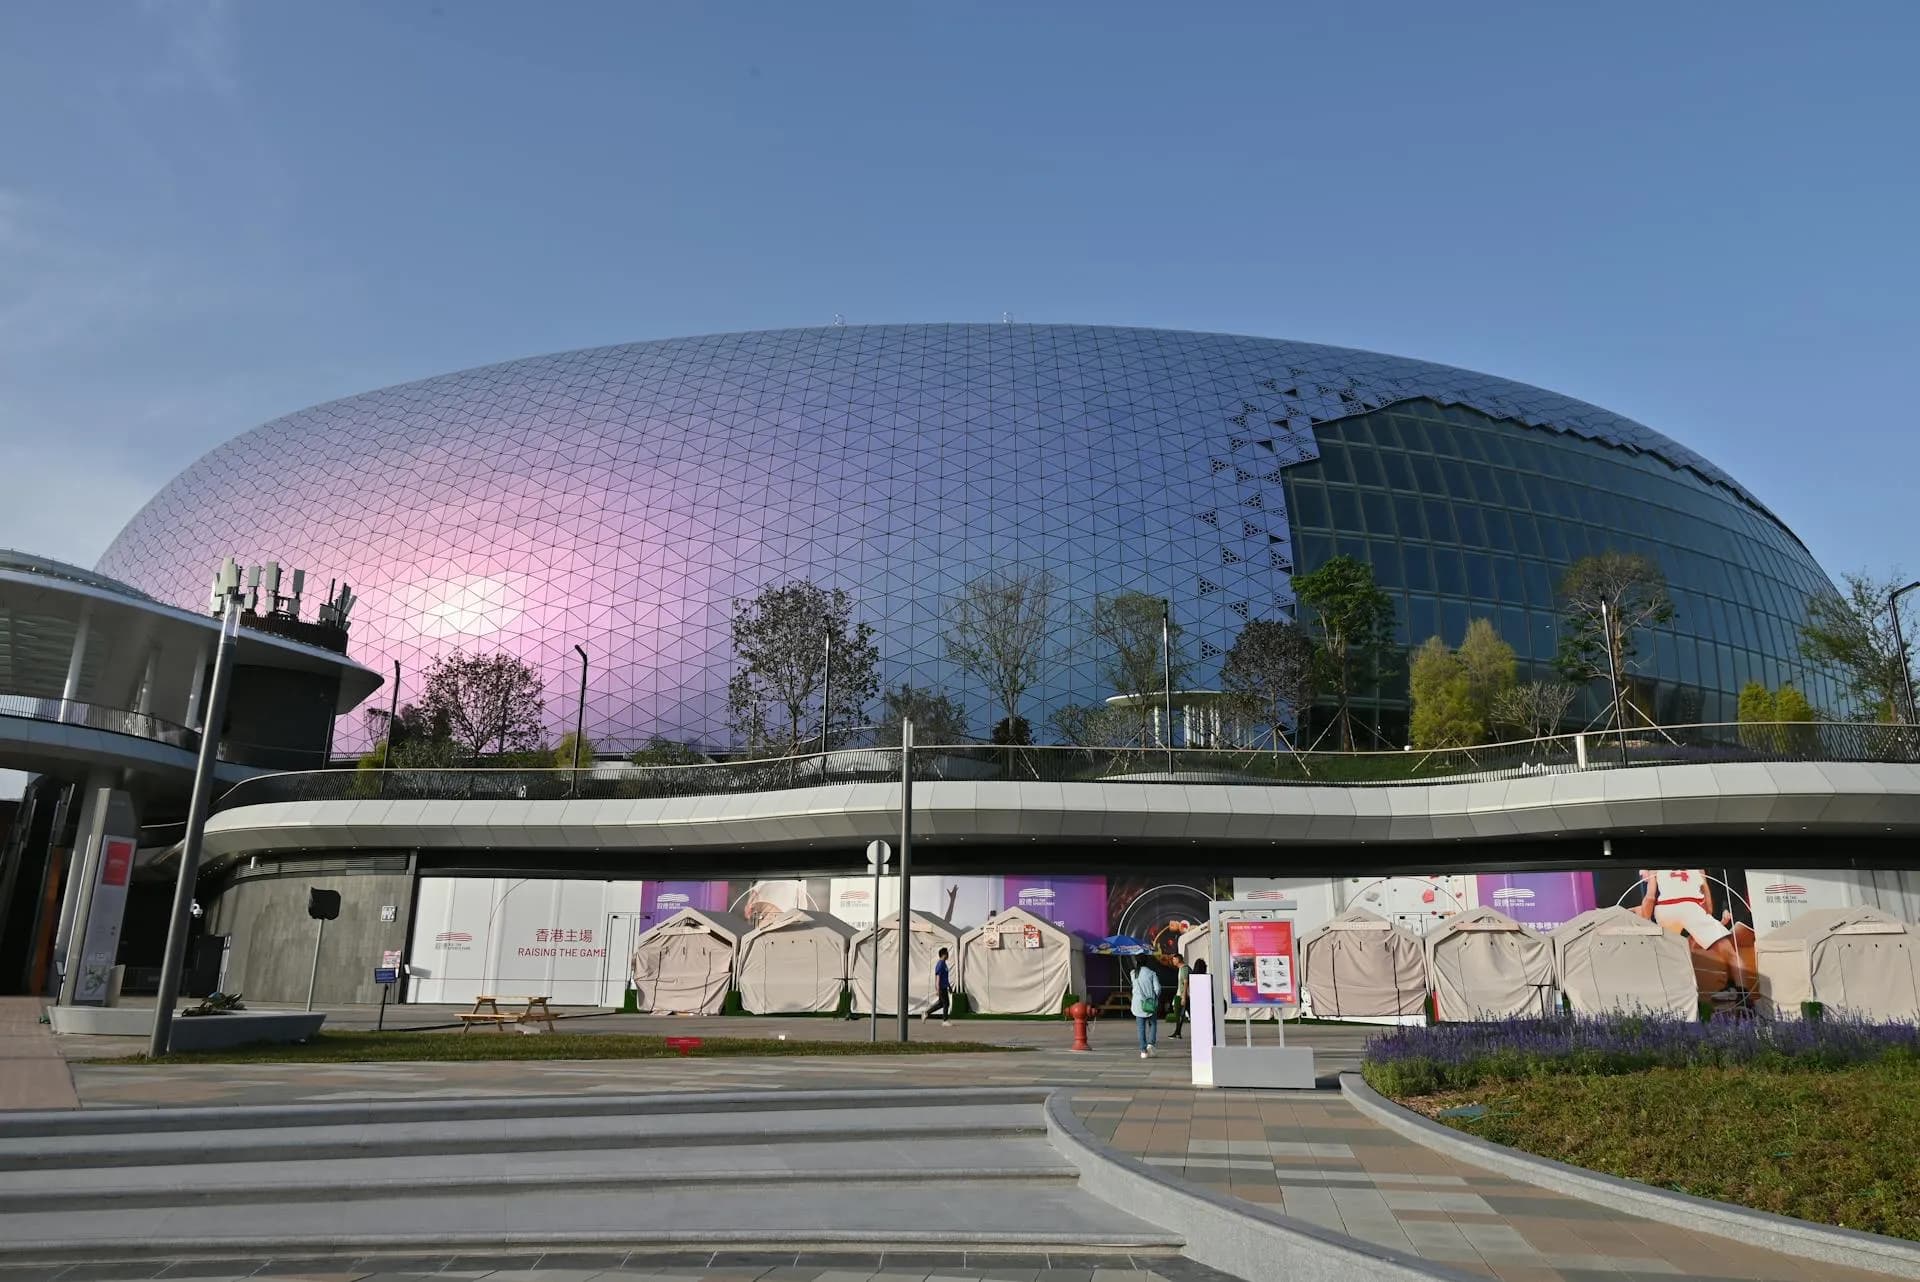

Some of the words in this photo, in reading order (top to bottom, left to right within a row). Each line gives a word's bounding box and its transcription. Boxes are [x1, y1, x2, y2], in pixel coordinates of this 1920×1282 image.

[535, 928, 593, 943] 香港主場
[518, 947, 557, 957] RAISING
[560, 948, 577, 957] THE
[579, 948, 607, 957] GAME
